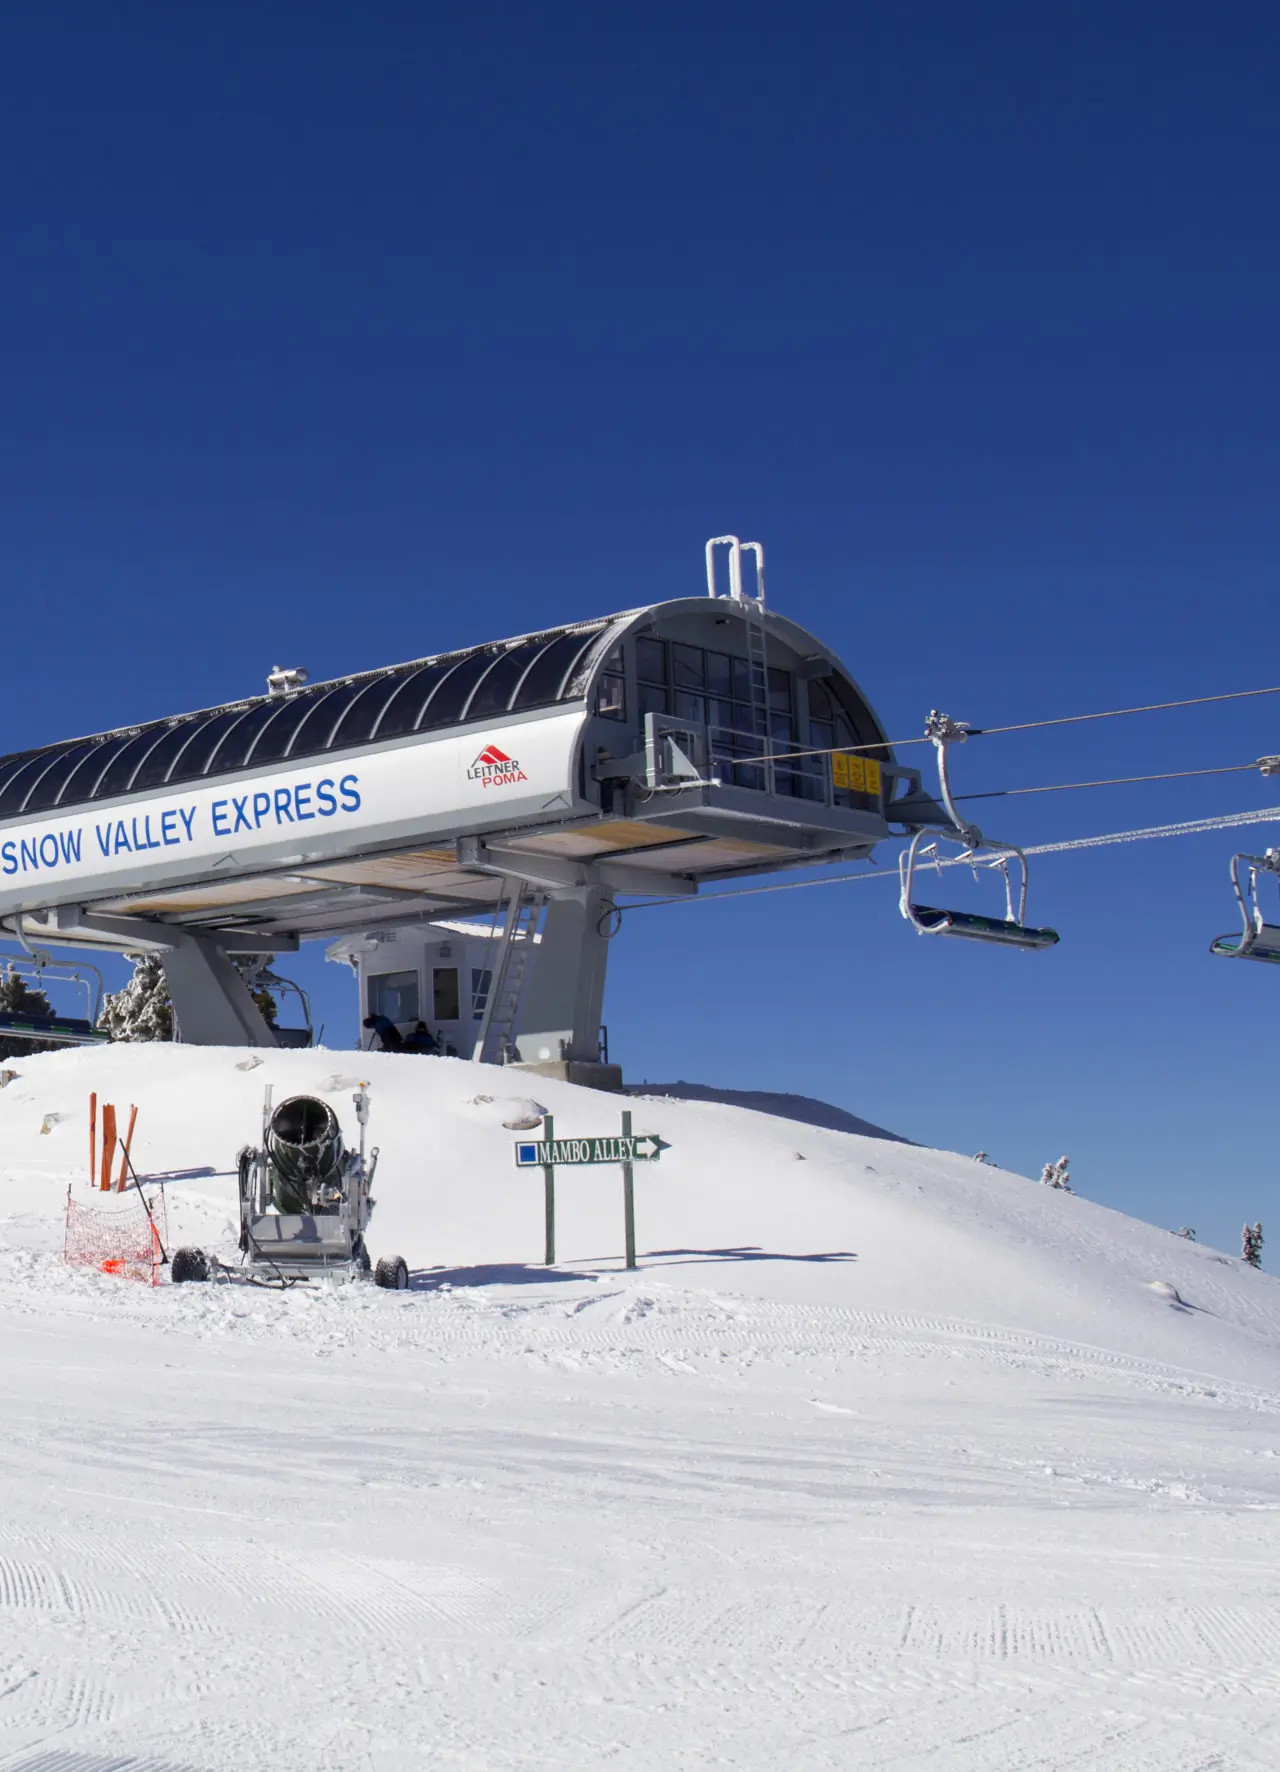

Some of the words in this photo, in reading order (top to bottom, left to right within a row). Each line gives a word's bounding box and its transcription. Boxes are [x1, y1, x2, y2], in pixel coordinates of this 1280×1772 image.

[467, 760, 520, 780] LEITNER
[482, 770, 528, 788] POMA
[1, 828, 82, 875] SNOW
[96, 806, 197, 857] VALLEY
[211, 774, 362, 837] EXPRESS
[538, 1140, 590, 1164] MAMBO
[593, 1137, 636, 1161] ALLEY
